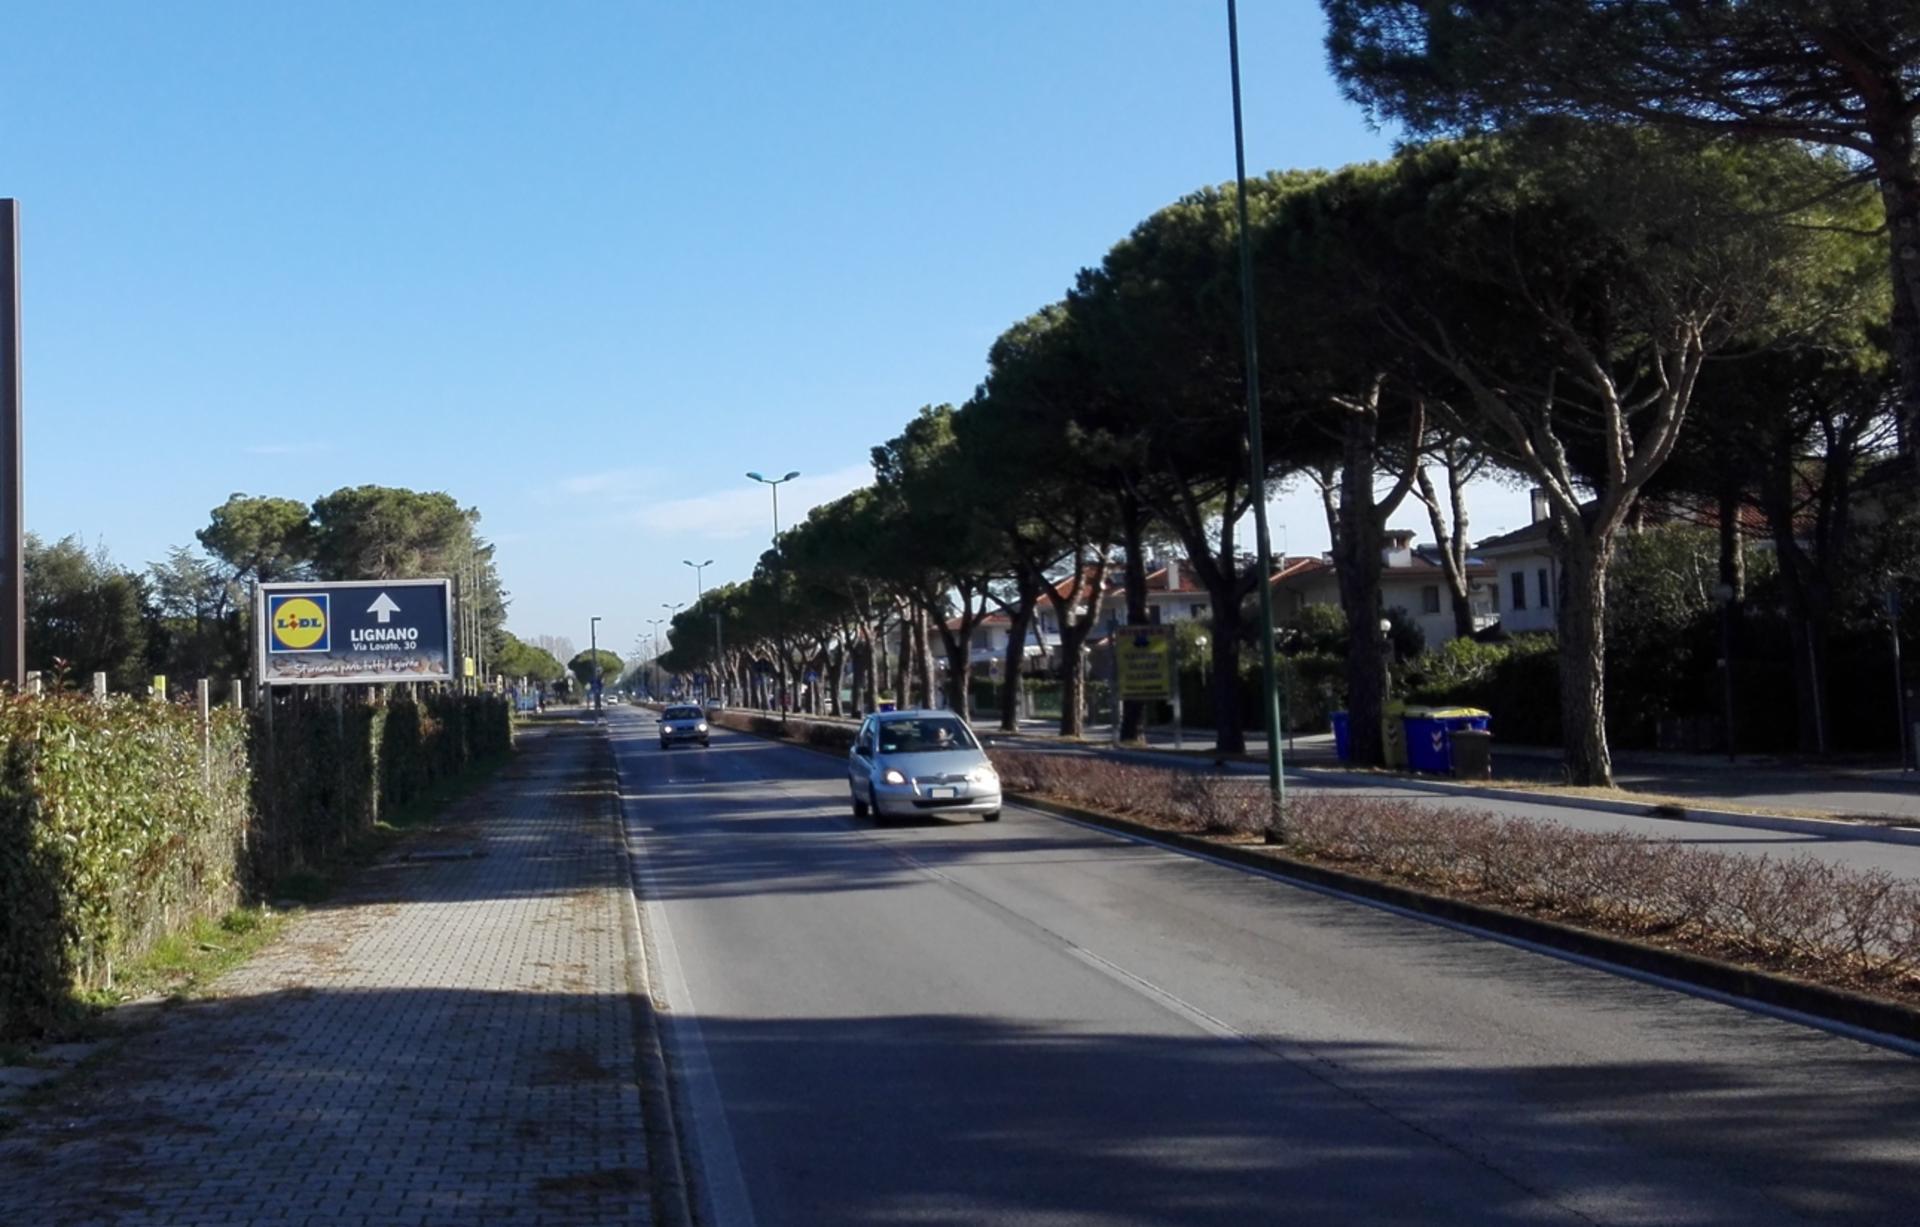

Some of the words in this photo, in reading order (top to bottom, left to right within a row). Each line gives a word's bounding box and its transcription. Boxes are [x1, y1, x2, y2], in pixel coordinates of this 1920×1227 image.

[351, 628, 418, 641] LIGNANO
[353, 643, 367, 651] Via
[369, 642, 401, 651] Lovato,
[404, 641, 417, 650] 30
